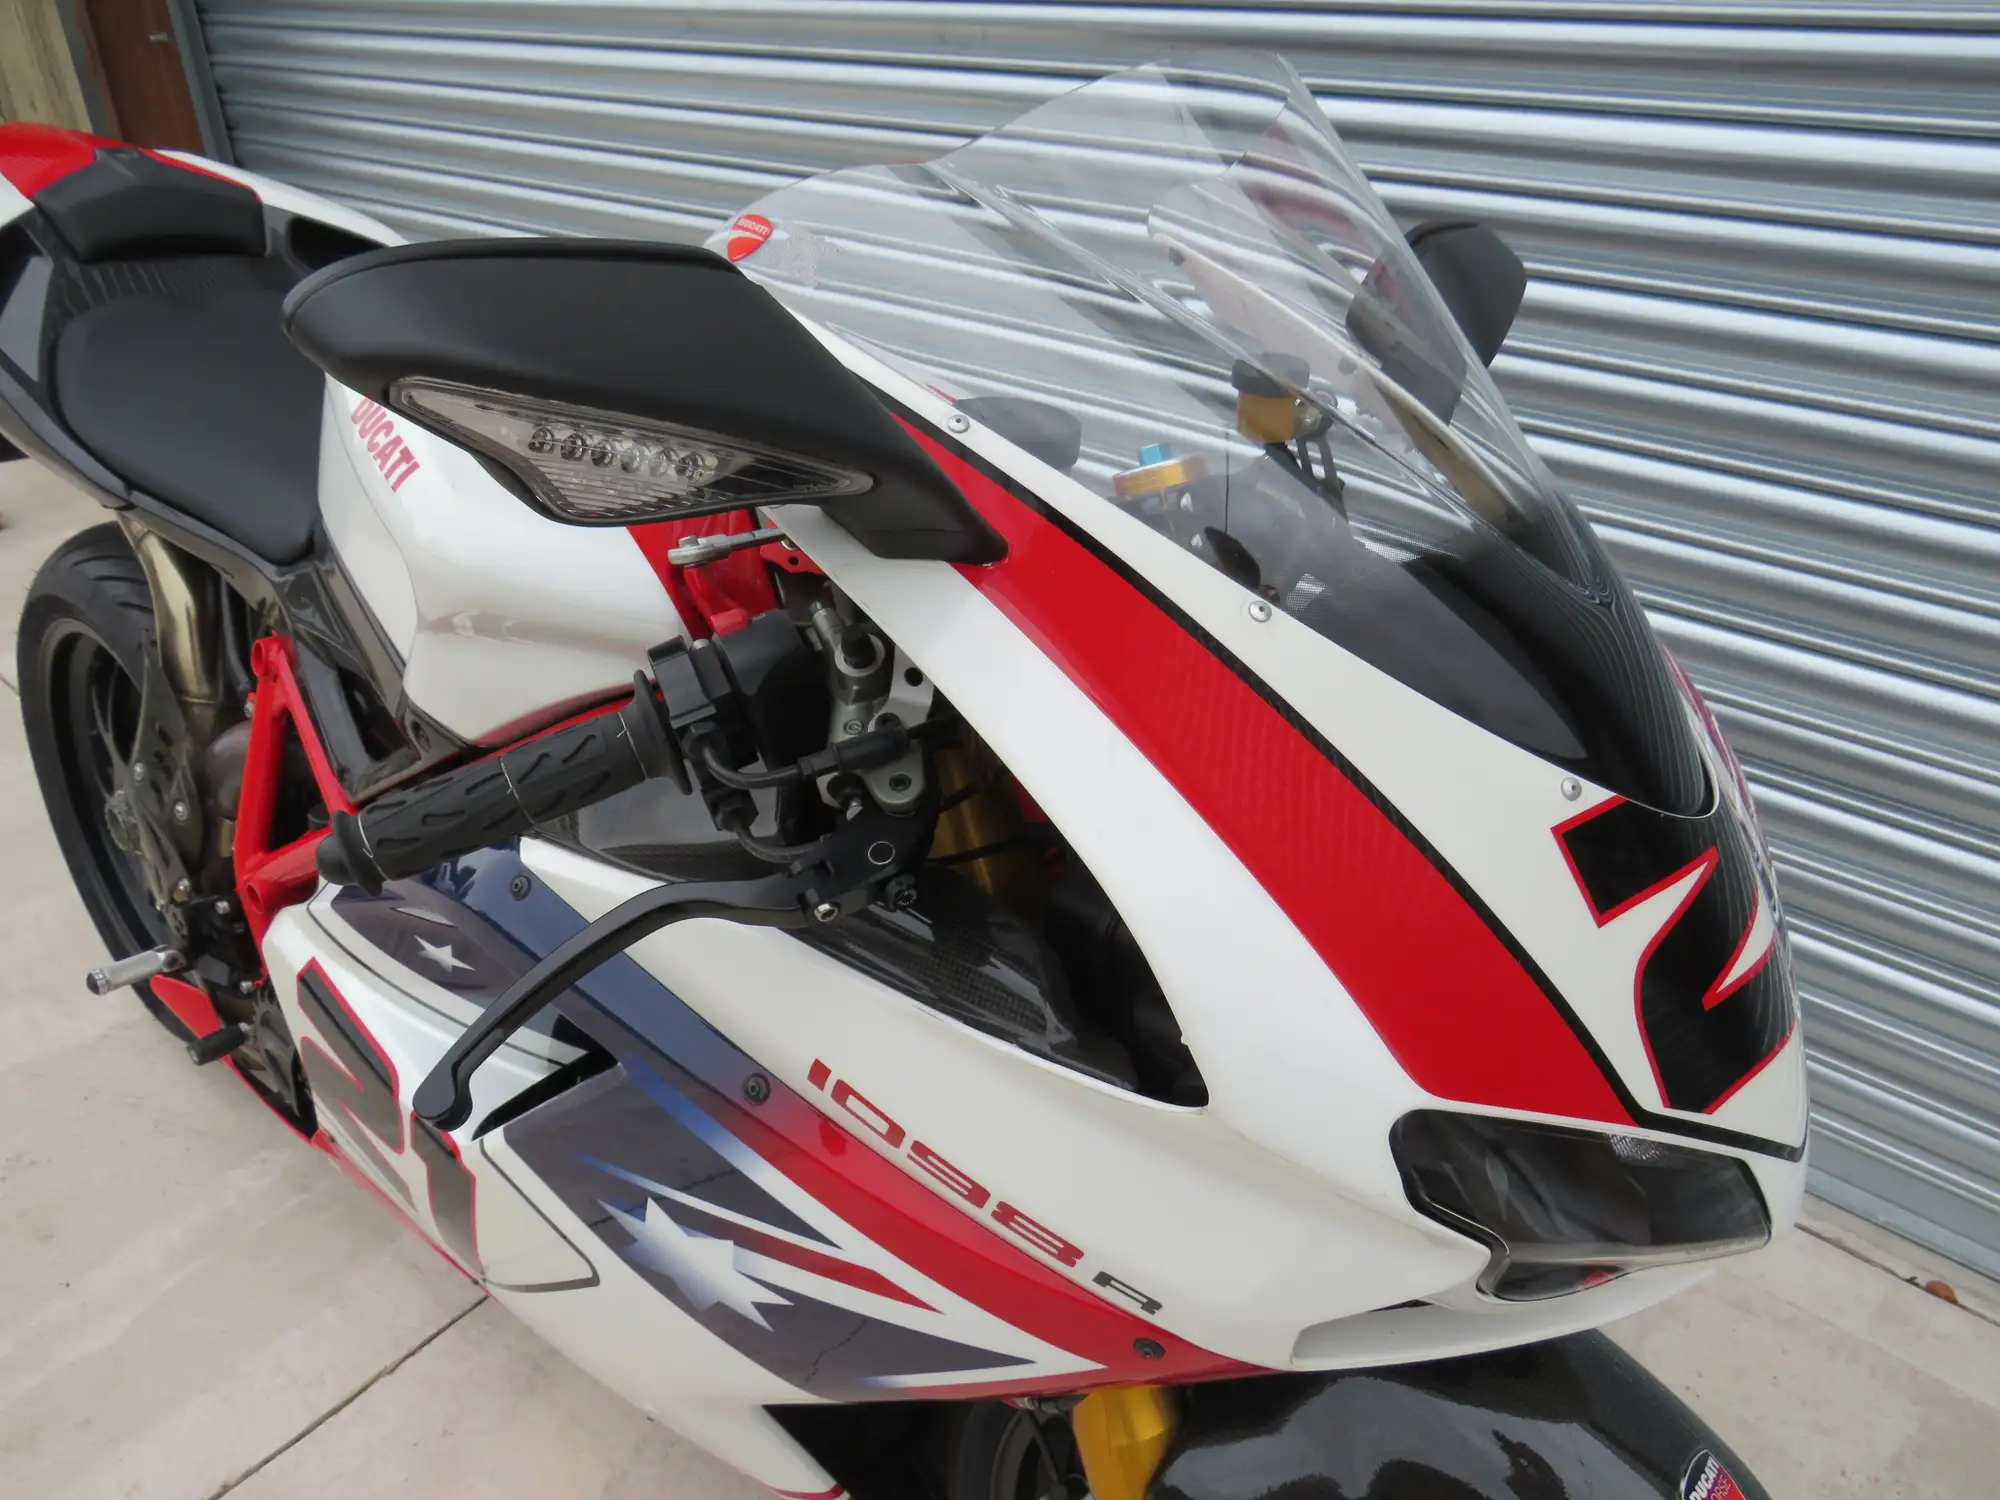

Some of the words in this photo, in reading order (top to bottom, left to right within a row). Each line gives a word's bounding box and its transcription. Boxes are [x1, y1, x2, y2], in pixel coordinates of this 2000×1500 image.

[735, 217, 771, 236] DUCATI
[807, 1058, 1085, 1268] 1098
[1092, 1271, 1163, 1316] R
[1711, 1474, 1731, 1500] ORSE
